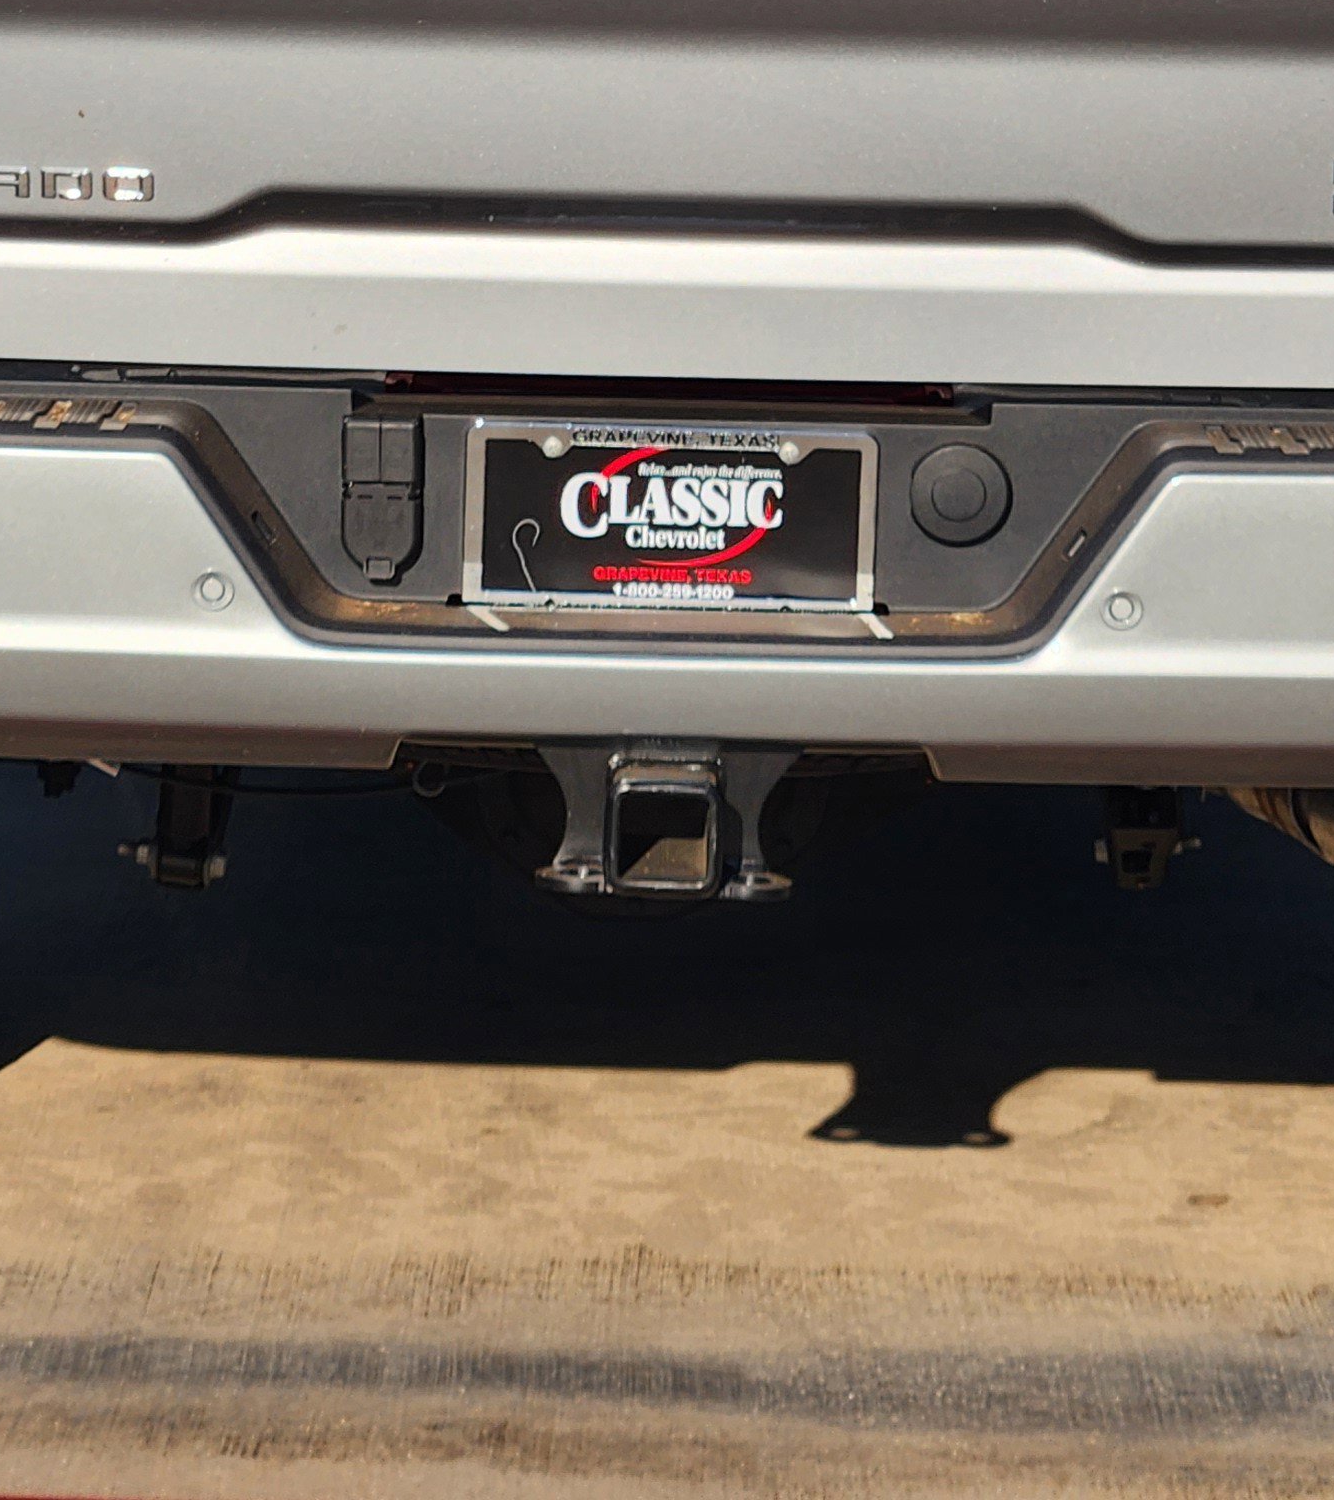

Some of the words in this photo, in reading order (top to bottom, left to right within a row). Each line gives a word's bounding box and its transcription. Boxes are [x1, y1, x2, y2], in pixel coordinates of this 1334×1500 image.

[559, 472, 784, 538] CLASSIC
[624, 523, 727, 551] Chevrolet
[592, 565, 692, 584] GRAPEVINE,
[695, 568, 753, 584] TEXAS
